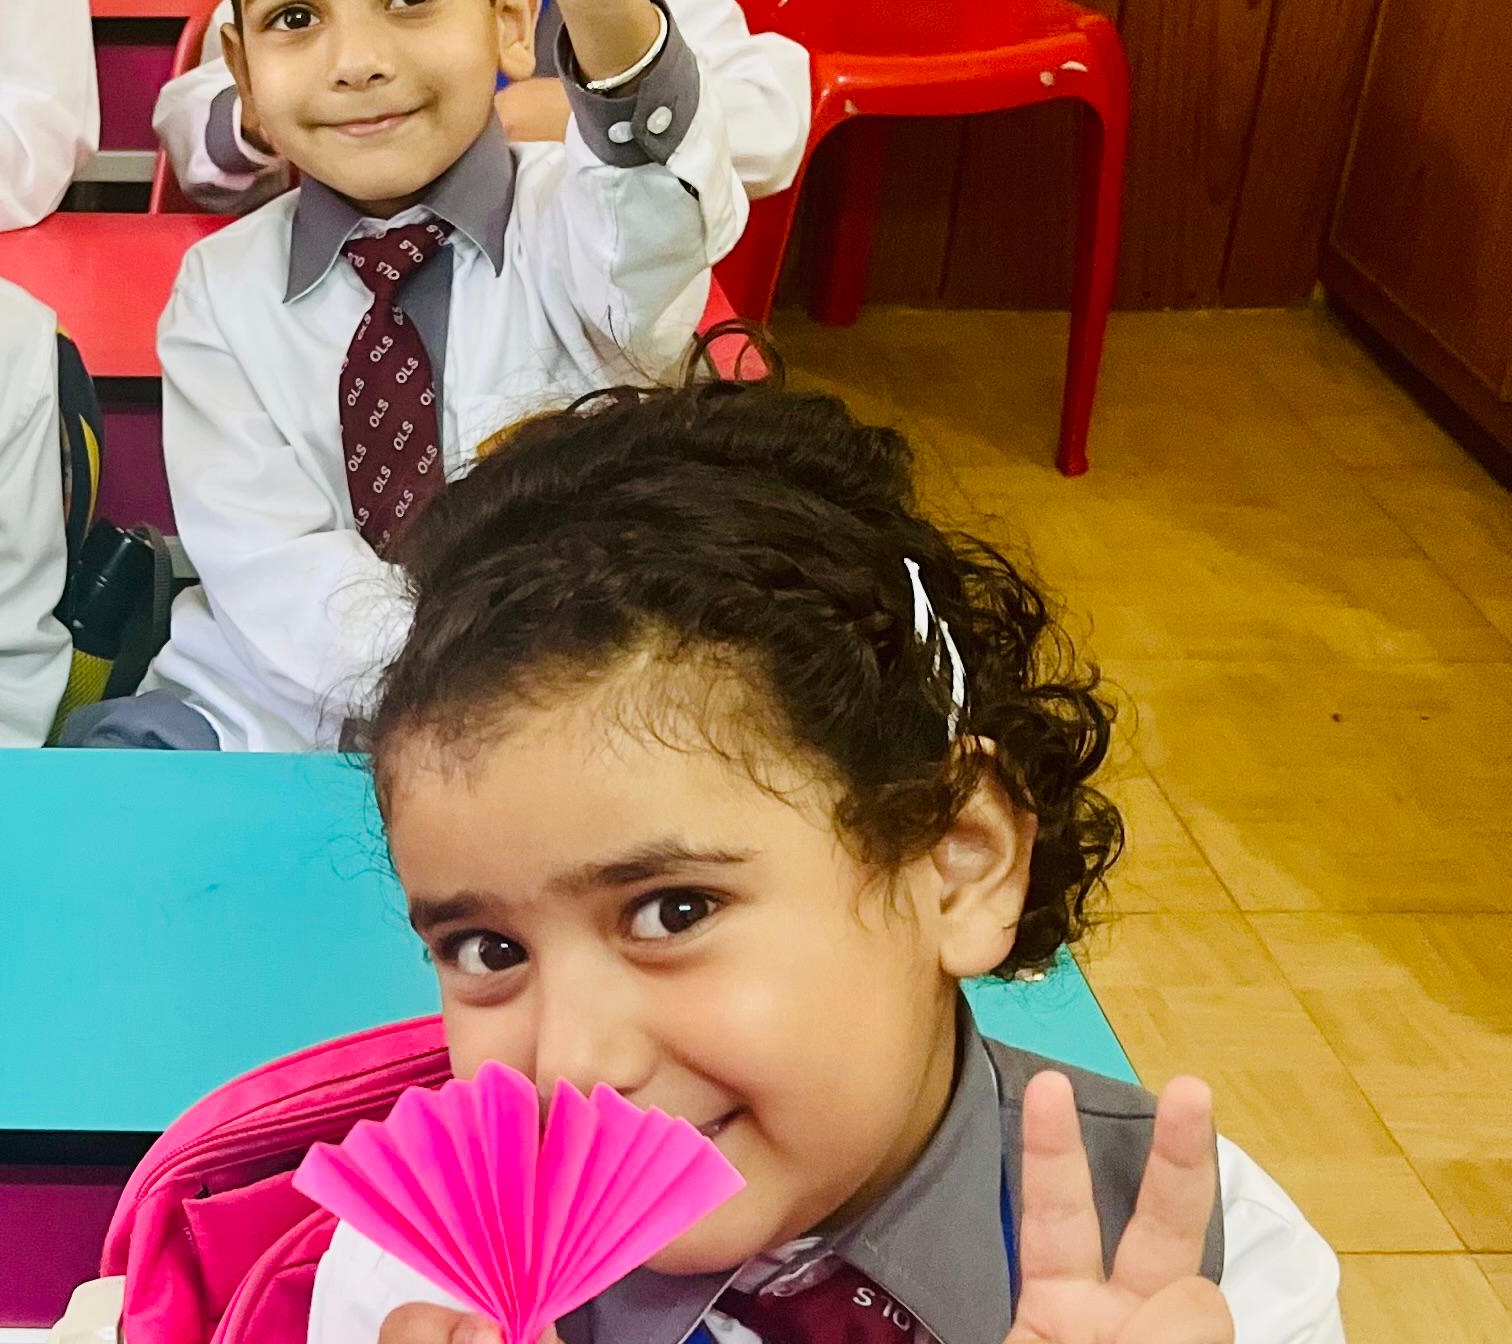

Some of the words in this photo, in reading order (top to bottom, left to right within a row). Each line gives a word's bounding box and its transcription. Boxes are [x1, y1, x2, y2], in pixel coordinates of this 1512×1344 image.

[399, 239, 424, 263] OLS
[376, 261, 401, 281] OLS
[369, 335, 394, 363] OLS
[395, 357, 419, 384] OLS
[346, 377, 365, 407] OLS
[369, 398, 389, 428] OLS
[393, 420, 414, 451] OLS
[347, 443, 367, 472] OLS
[417, 444, 438, 474] OLS
[372, 465, 392, 494] OLS
[395, 489, 414, 518] OLS
[851, 1286, 913, 1332] OLS
